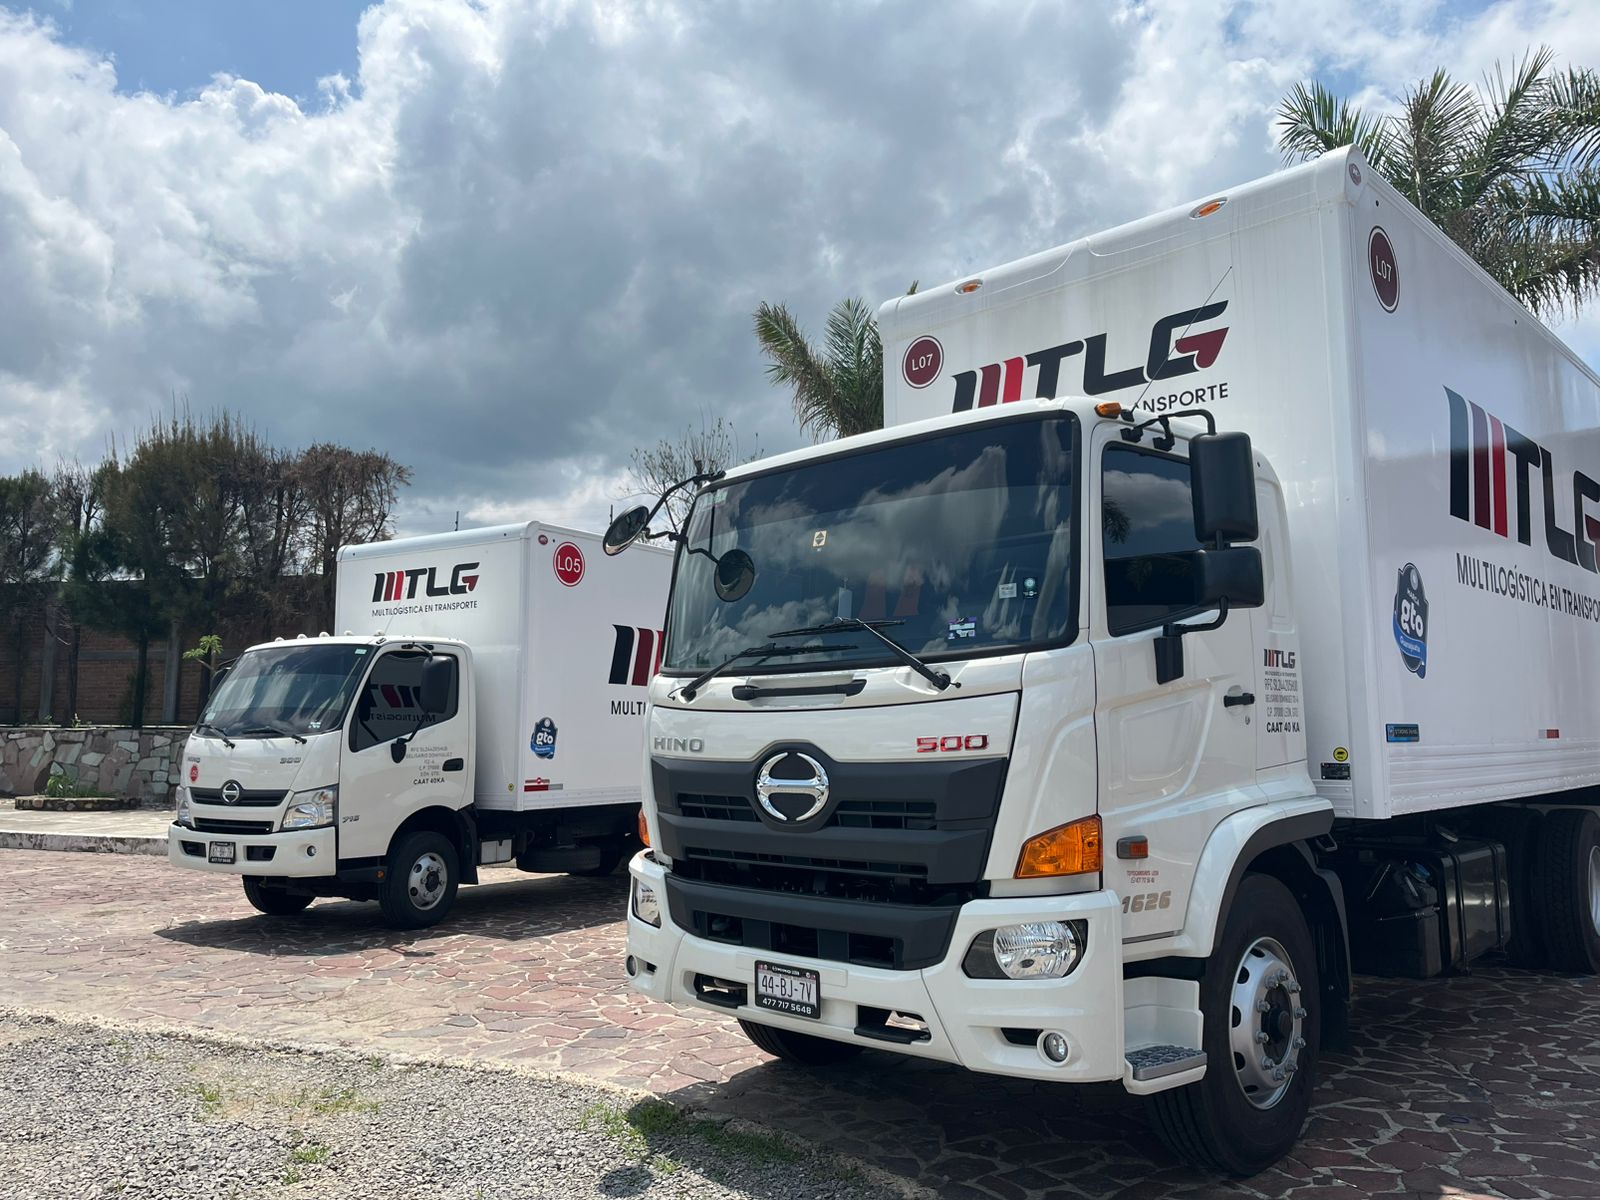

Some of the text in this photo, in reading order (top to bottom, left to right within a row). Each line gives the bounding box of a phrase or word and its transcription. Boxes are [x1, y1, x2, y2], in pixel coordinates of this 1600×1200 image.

[1375, 255, 1392, 283] L07
[912, 353, 934, 371] L07
[1136, 383, 1228, 412] NSPORTE
[557, 556, 581, 573] L05
[1456, 552, 1548, 608] MULTILOGÍSTICA
[1550, 584, 1562, 611] EN
[425, 605, 433, 613] EN
[435, 601, 478, 611] TRANSPORTE
[1401, 599, 1423, 637] gto
[1267, 722, 1283, 733] CAAT
[536, 732, 553, 746] gto
[654, 736, 705, 752] HINO
[916, 734, 989, 752] 500
[1122, 890, 1171, 914] 1626
[762, 975, 812, 1002] 44-BJ-7V
[763, 998, 812, 1014] 477 717 5648
